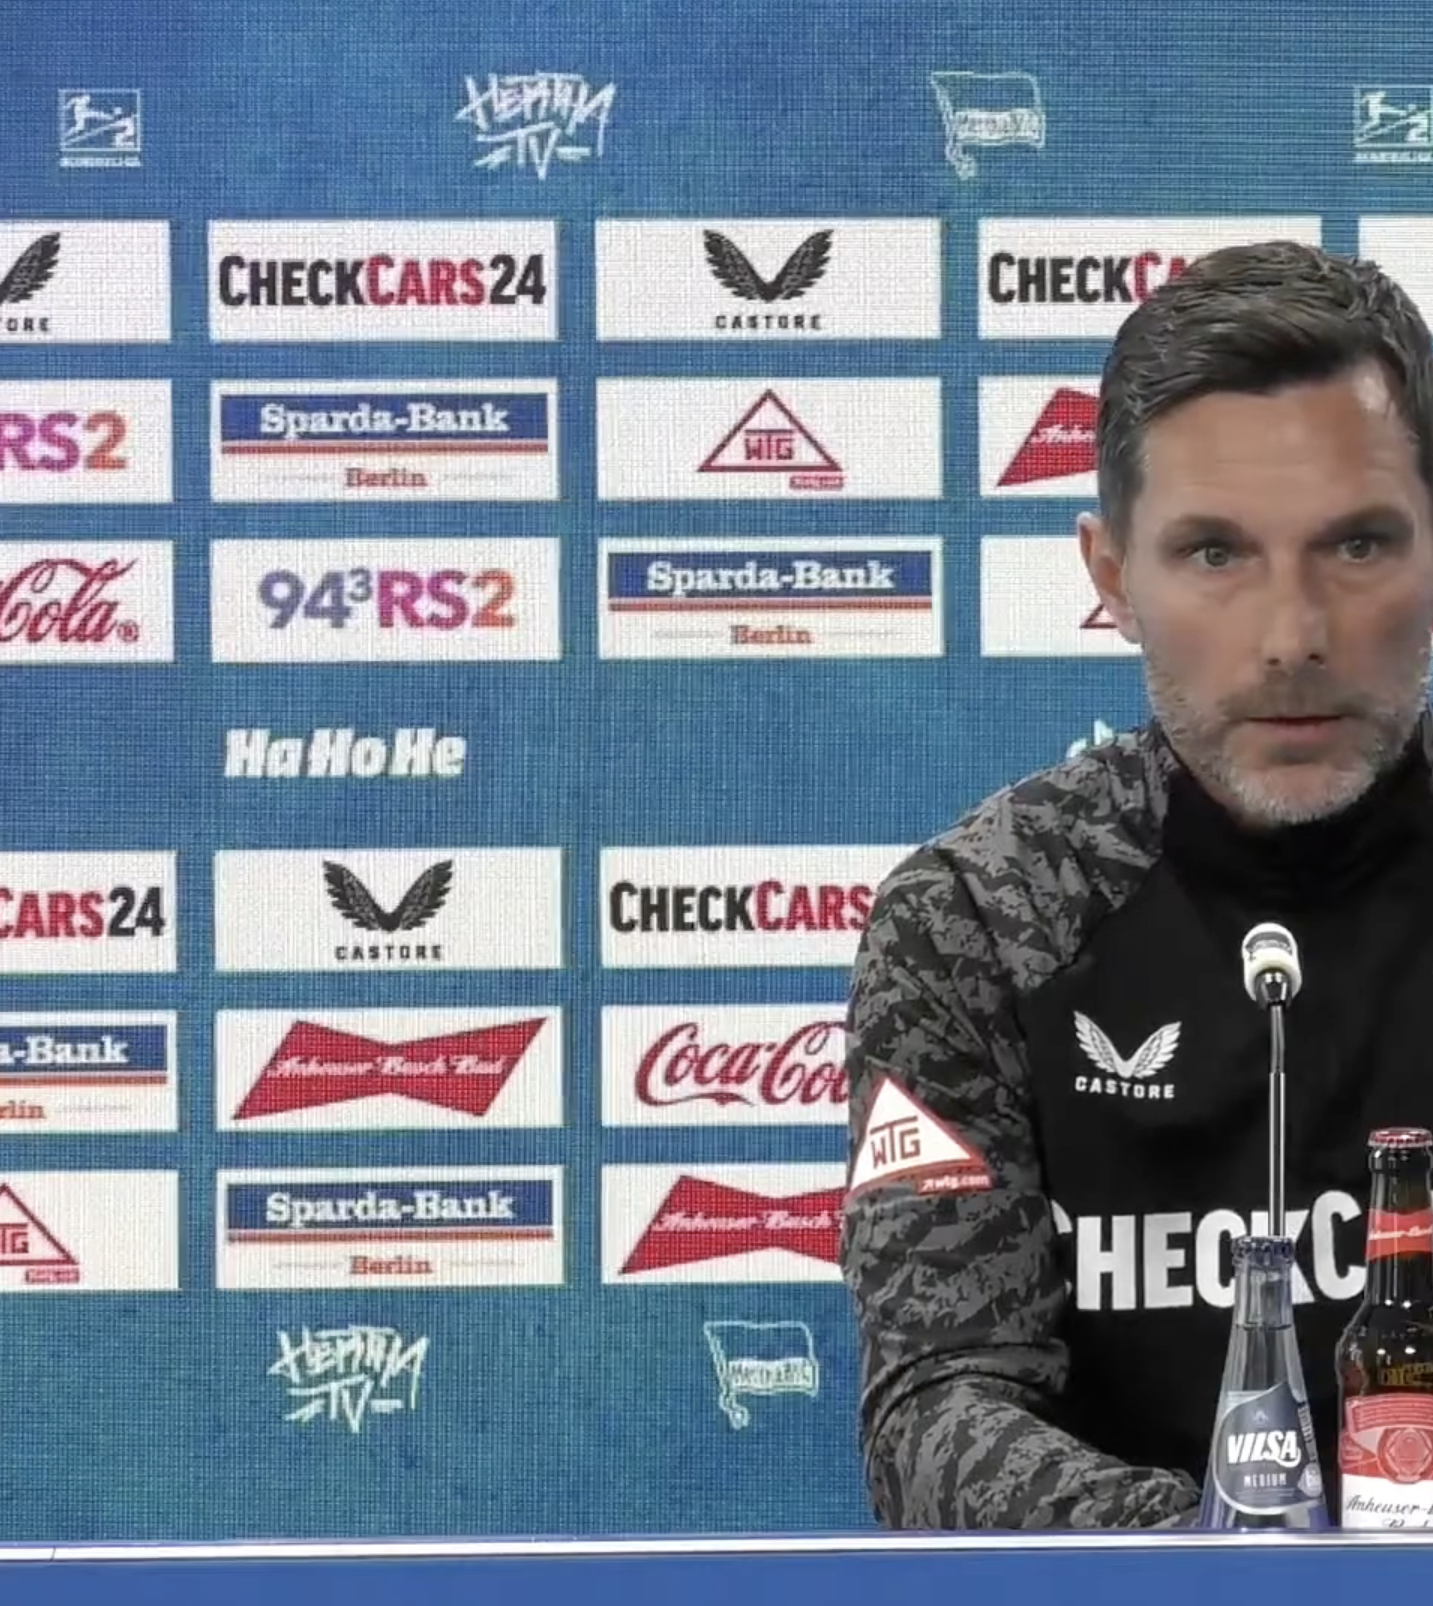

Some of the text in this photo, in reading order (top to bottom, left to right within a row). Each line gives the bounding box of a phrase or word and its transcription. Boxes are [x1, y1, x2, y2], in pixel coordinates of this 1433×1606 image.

[219, 253, 547, 306] CHECKCARS24
[714, 314, 821, 329] CASTORE
[259, 402, 510, 437] Sparda-Bank
[344, 466, 428, 488] Berlin
[646, 559, 895, 597] Sparda-Bank
[730, 624, 813, 645] Berlin
[335, 945, 442, 961] CASTORE
[1073, 1075, 1177, 1100] CASTORE
[870, 1114, 921, 1169] WTG
[265, 1190, 516, 1229] Sparda-Bank
[349, 1255, 434, 1276] Berlin
[1227, 1430, 1302, 1468] VILSA
[1243, 1473, 1287, 1488] MEDIUM
